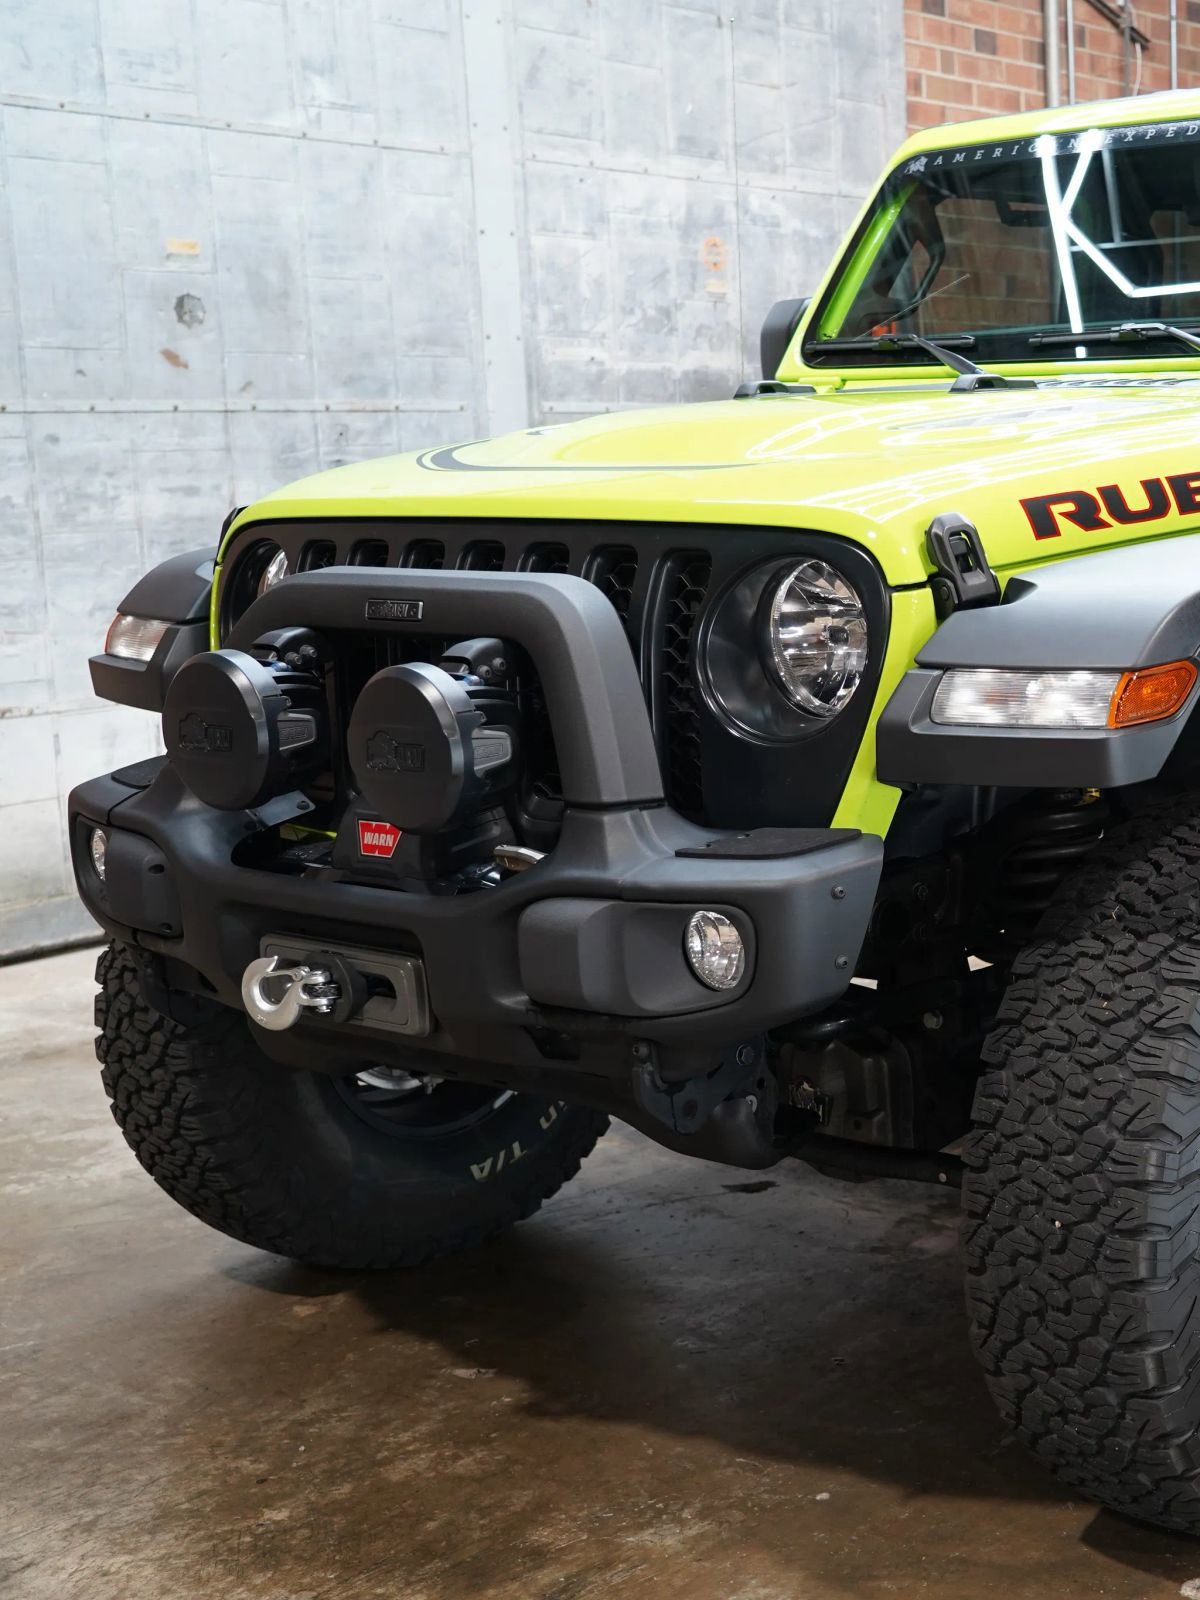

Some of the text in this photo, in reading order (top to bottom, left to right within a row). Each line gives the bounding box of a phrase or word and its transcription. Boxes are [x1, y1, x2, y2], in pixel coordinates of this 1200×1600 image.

[933, 137, 1081, 166] AMERICN
[364, 831, 394, 847] WARN
[469, 1140, 527, 1182] T/A
